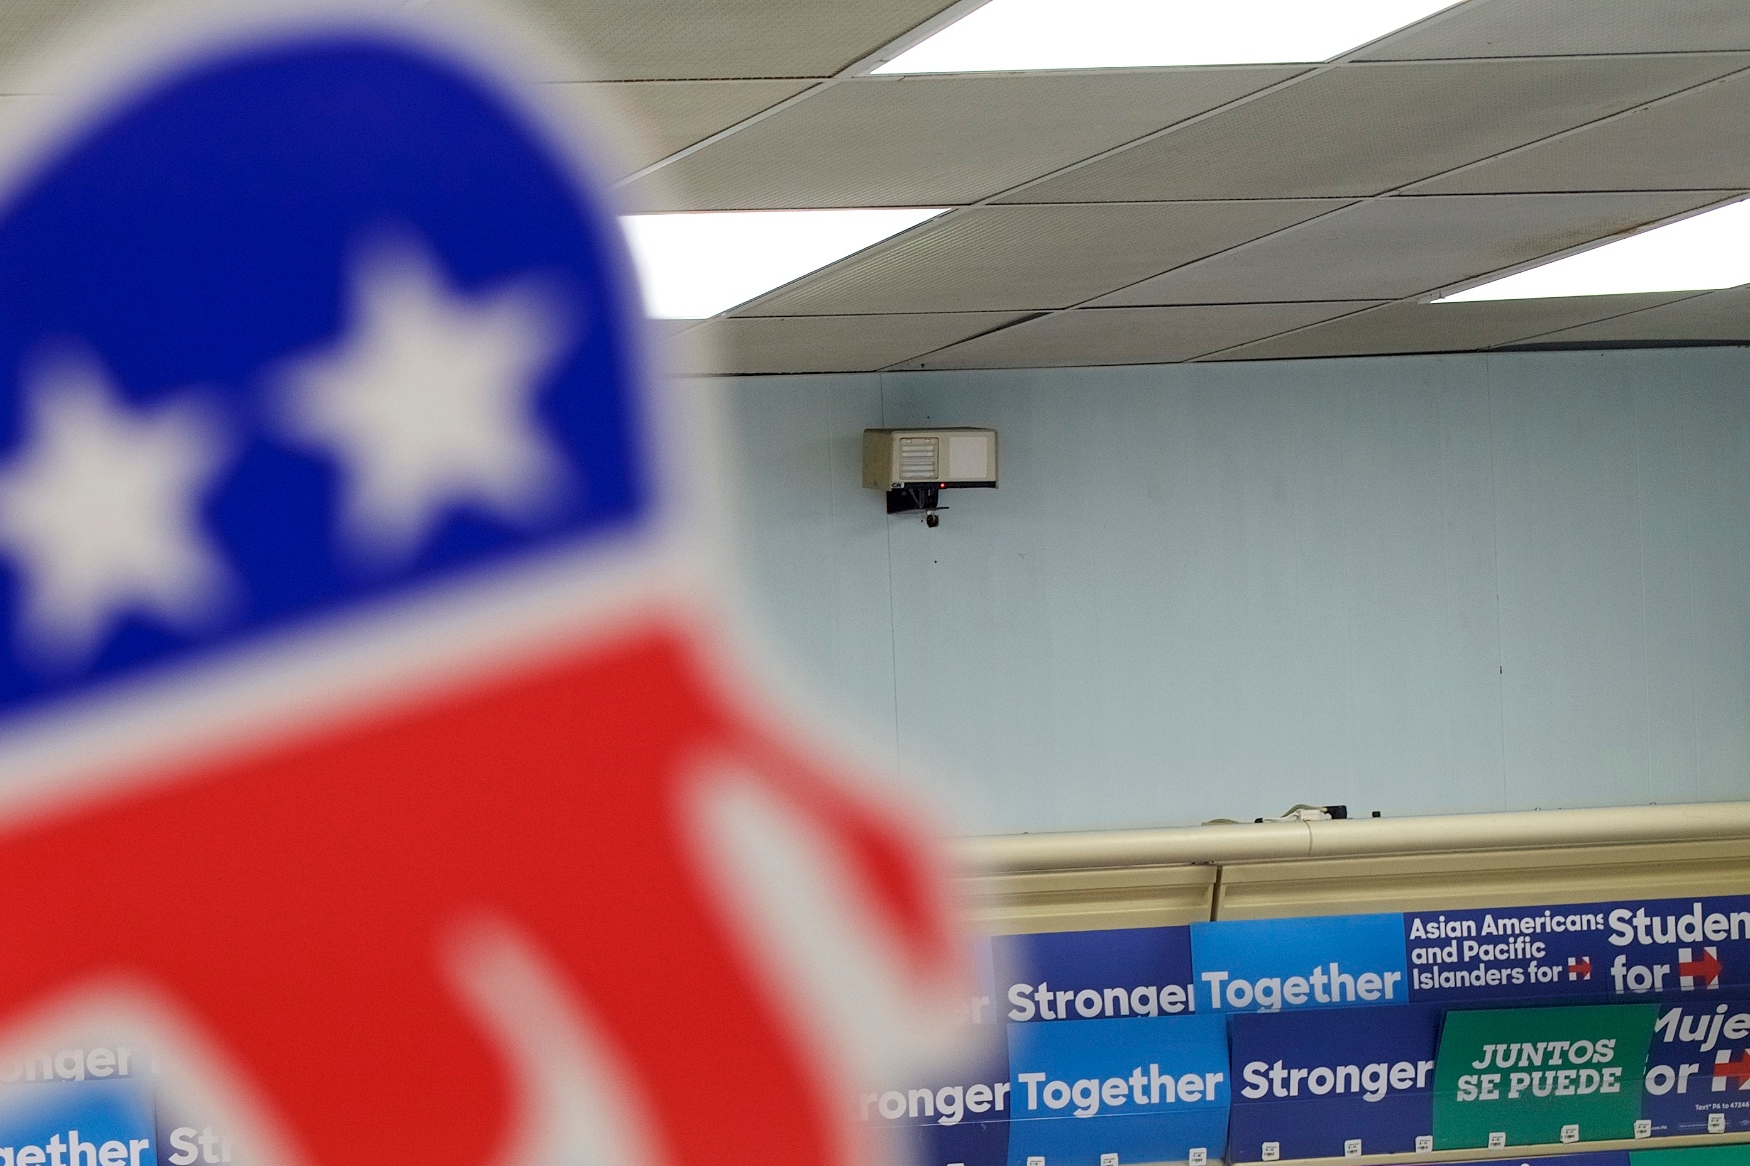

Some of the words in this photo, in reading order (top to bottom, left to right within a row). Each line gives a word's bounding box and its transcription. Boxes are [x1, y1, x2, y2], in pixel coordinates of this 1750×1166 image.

[1410, 916, 1476, 939] Asian
[1412, 940, 1457, 964] and
[1463, 936, 1545, 961] Pacific
[1202, 963, 1401, 1013] Together
[1413, 963, 1524, 989] Islanders
[1528, 961, 1562, 983] for
[1611, 955, 1670, 994] for
[1472, 1039, 1616, 1069] JUNTOS
[1018, 1064, 1223, 1118] Together
[1241, 1060, 1433, 1102] Stronger
[1457, 1074, 1501, 1101] SE
[1508, 1067, 1622, 1098] PUEDE
[1643, 1054, 1699, 1095] or
